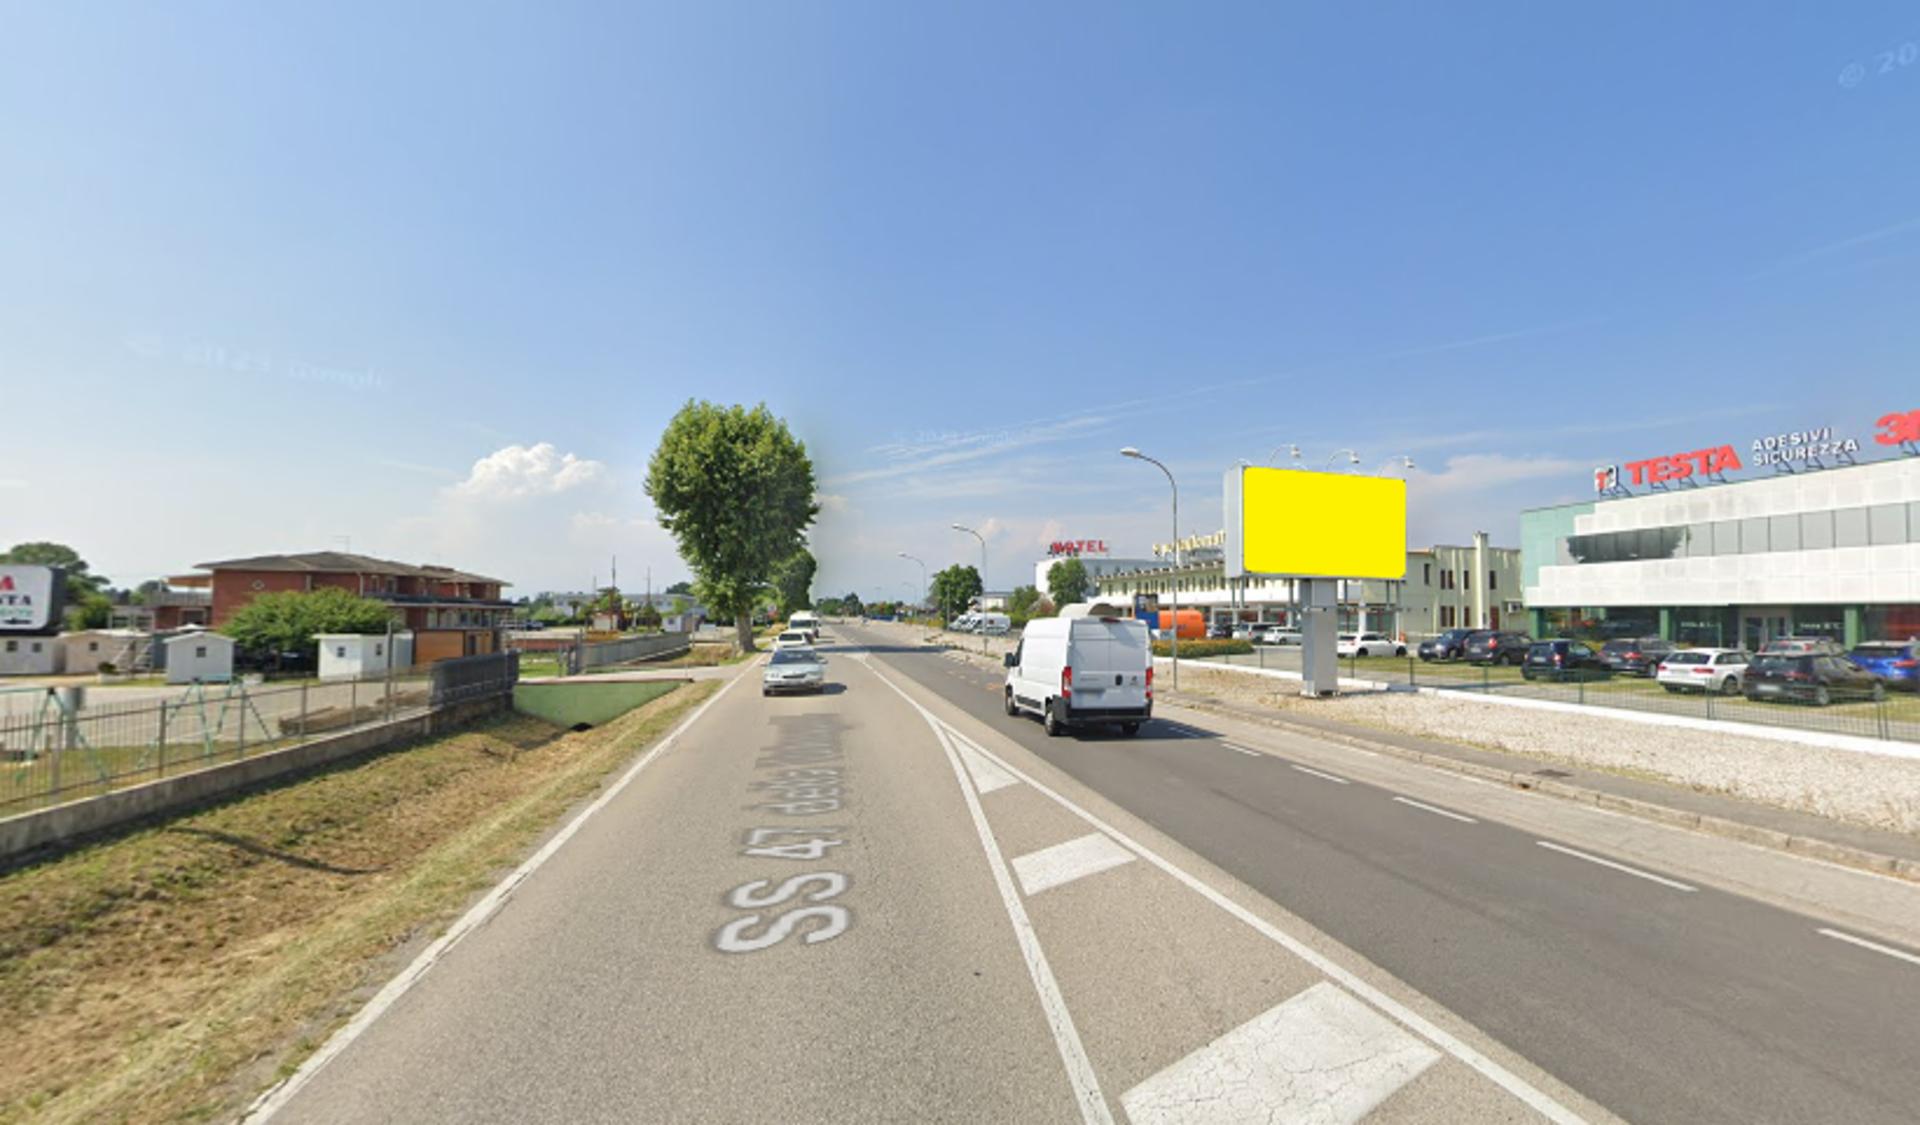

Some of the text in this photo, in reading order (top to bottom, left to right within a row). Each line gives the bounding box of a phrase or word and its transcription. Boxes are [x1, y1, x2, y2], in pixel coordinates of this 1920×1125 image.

[1752, 427, 1830, 451] ADESIVI
[1752, 439, 1858, 466] SICUREZZA
[1624, 444, 1743, 486] TESTA
